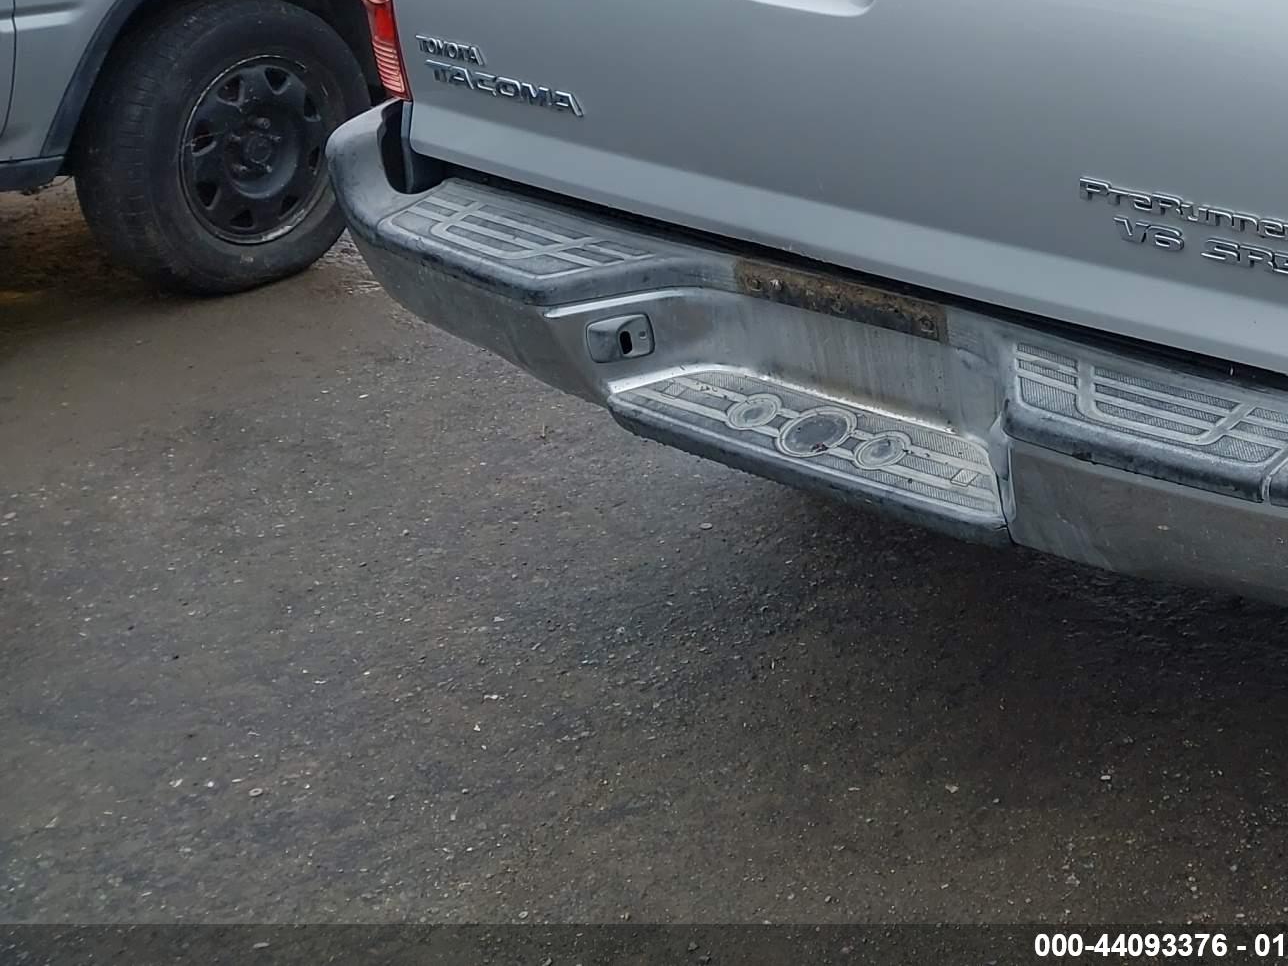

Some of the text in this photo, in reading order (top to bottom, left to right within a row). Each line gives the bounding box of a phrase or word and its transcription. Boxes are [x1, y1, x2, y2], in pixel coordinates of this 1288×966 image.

[415, 35, 486, 66] TOYOTA
[425, 59, 583, 117] TACOMA
[1113, 216, 1185, 251] V6
